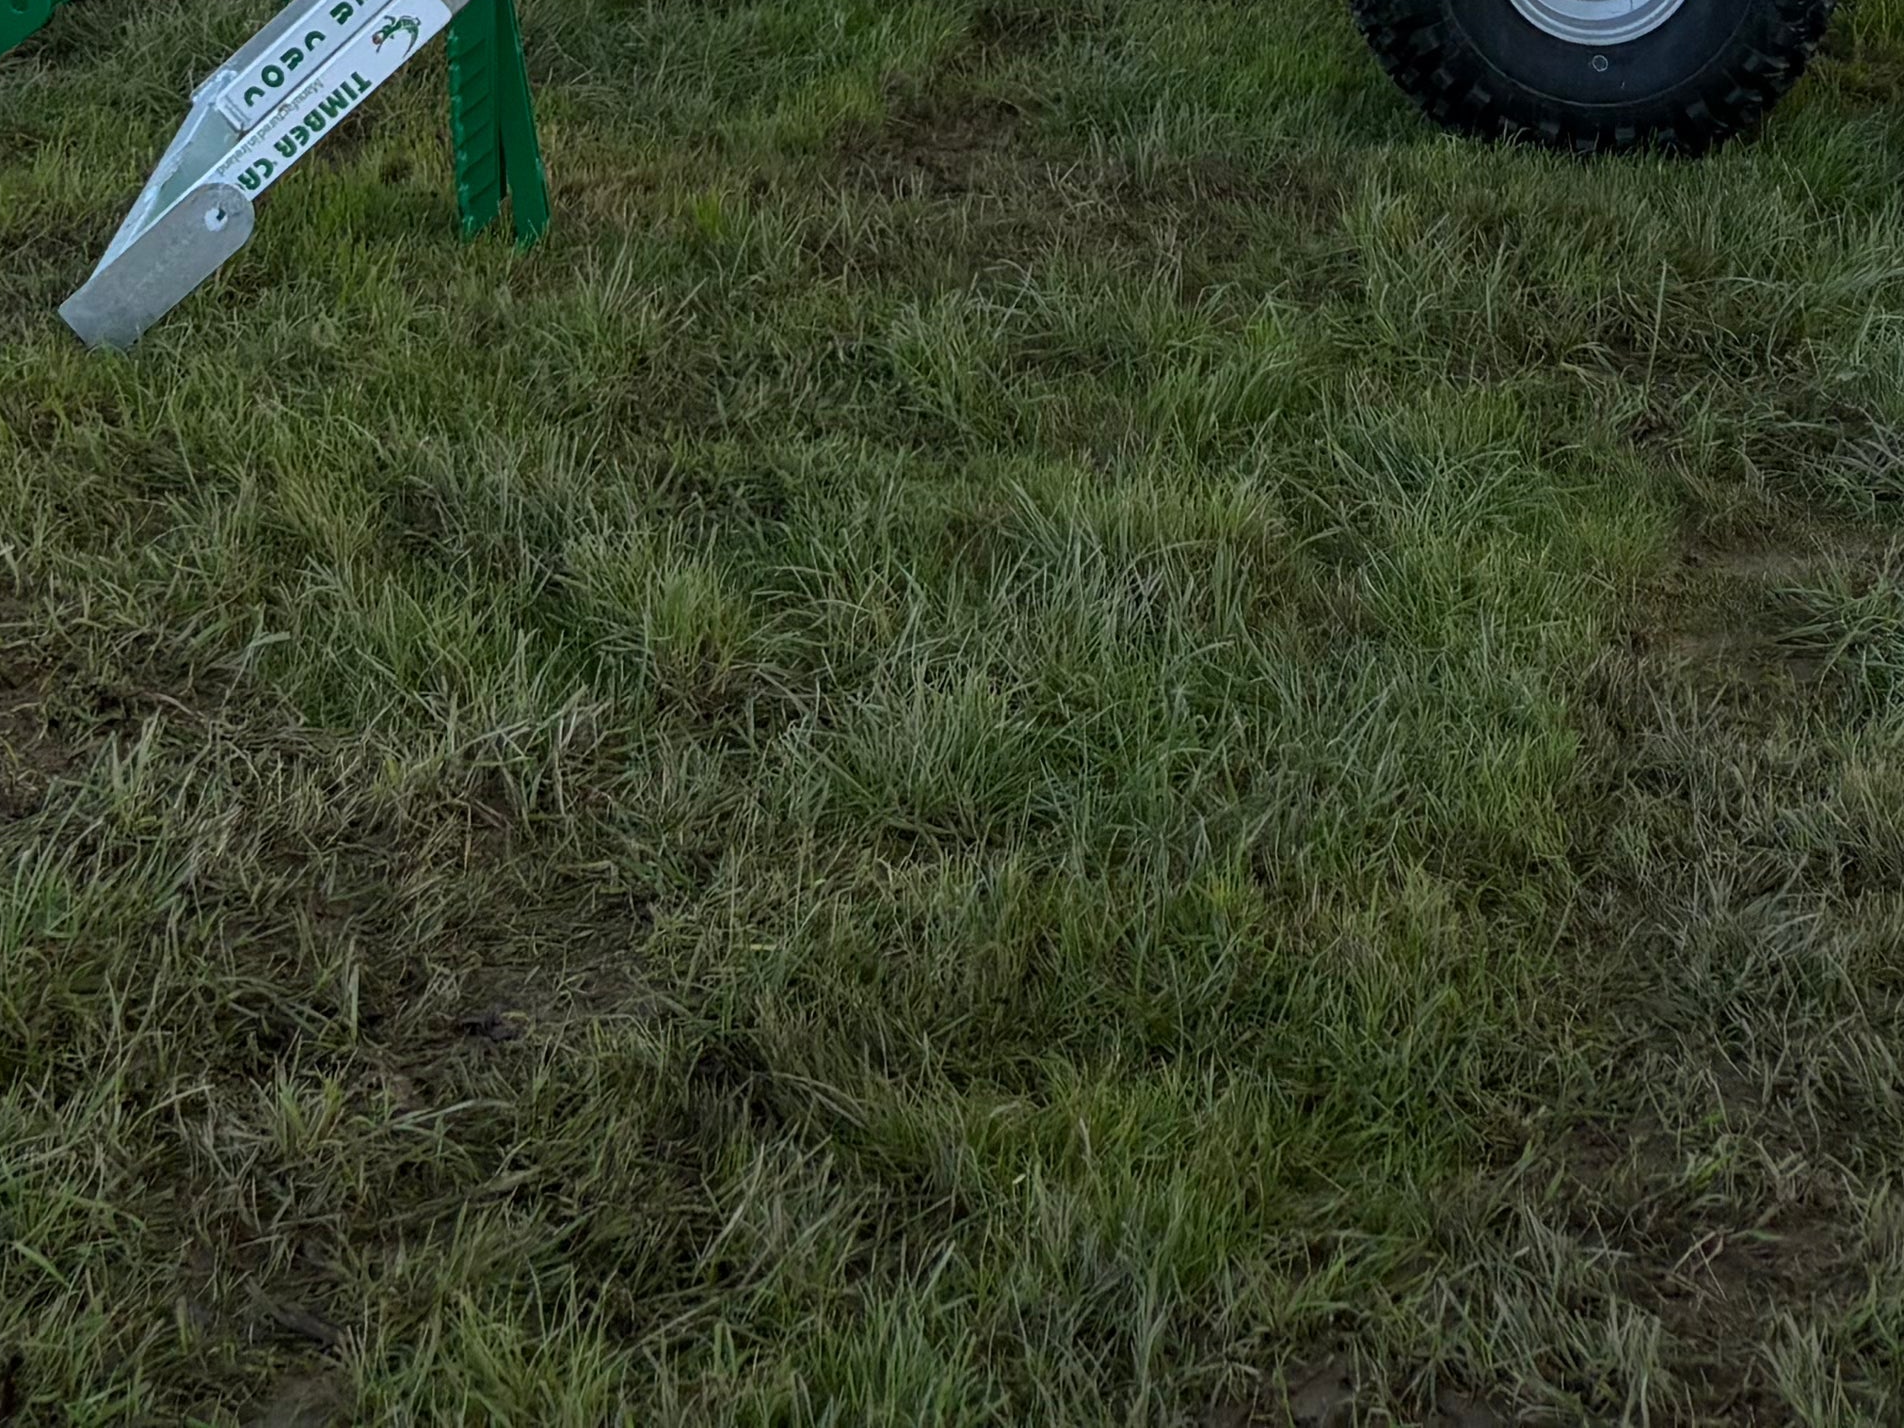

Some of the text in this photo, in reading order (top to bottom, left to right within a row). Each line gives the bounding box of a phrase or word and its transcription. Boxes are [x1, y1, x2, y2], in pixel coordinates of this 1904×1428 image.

[243, 30, 327, 108] CROC
[236, 70, 373, 192] TIMBER CR
